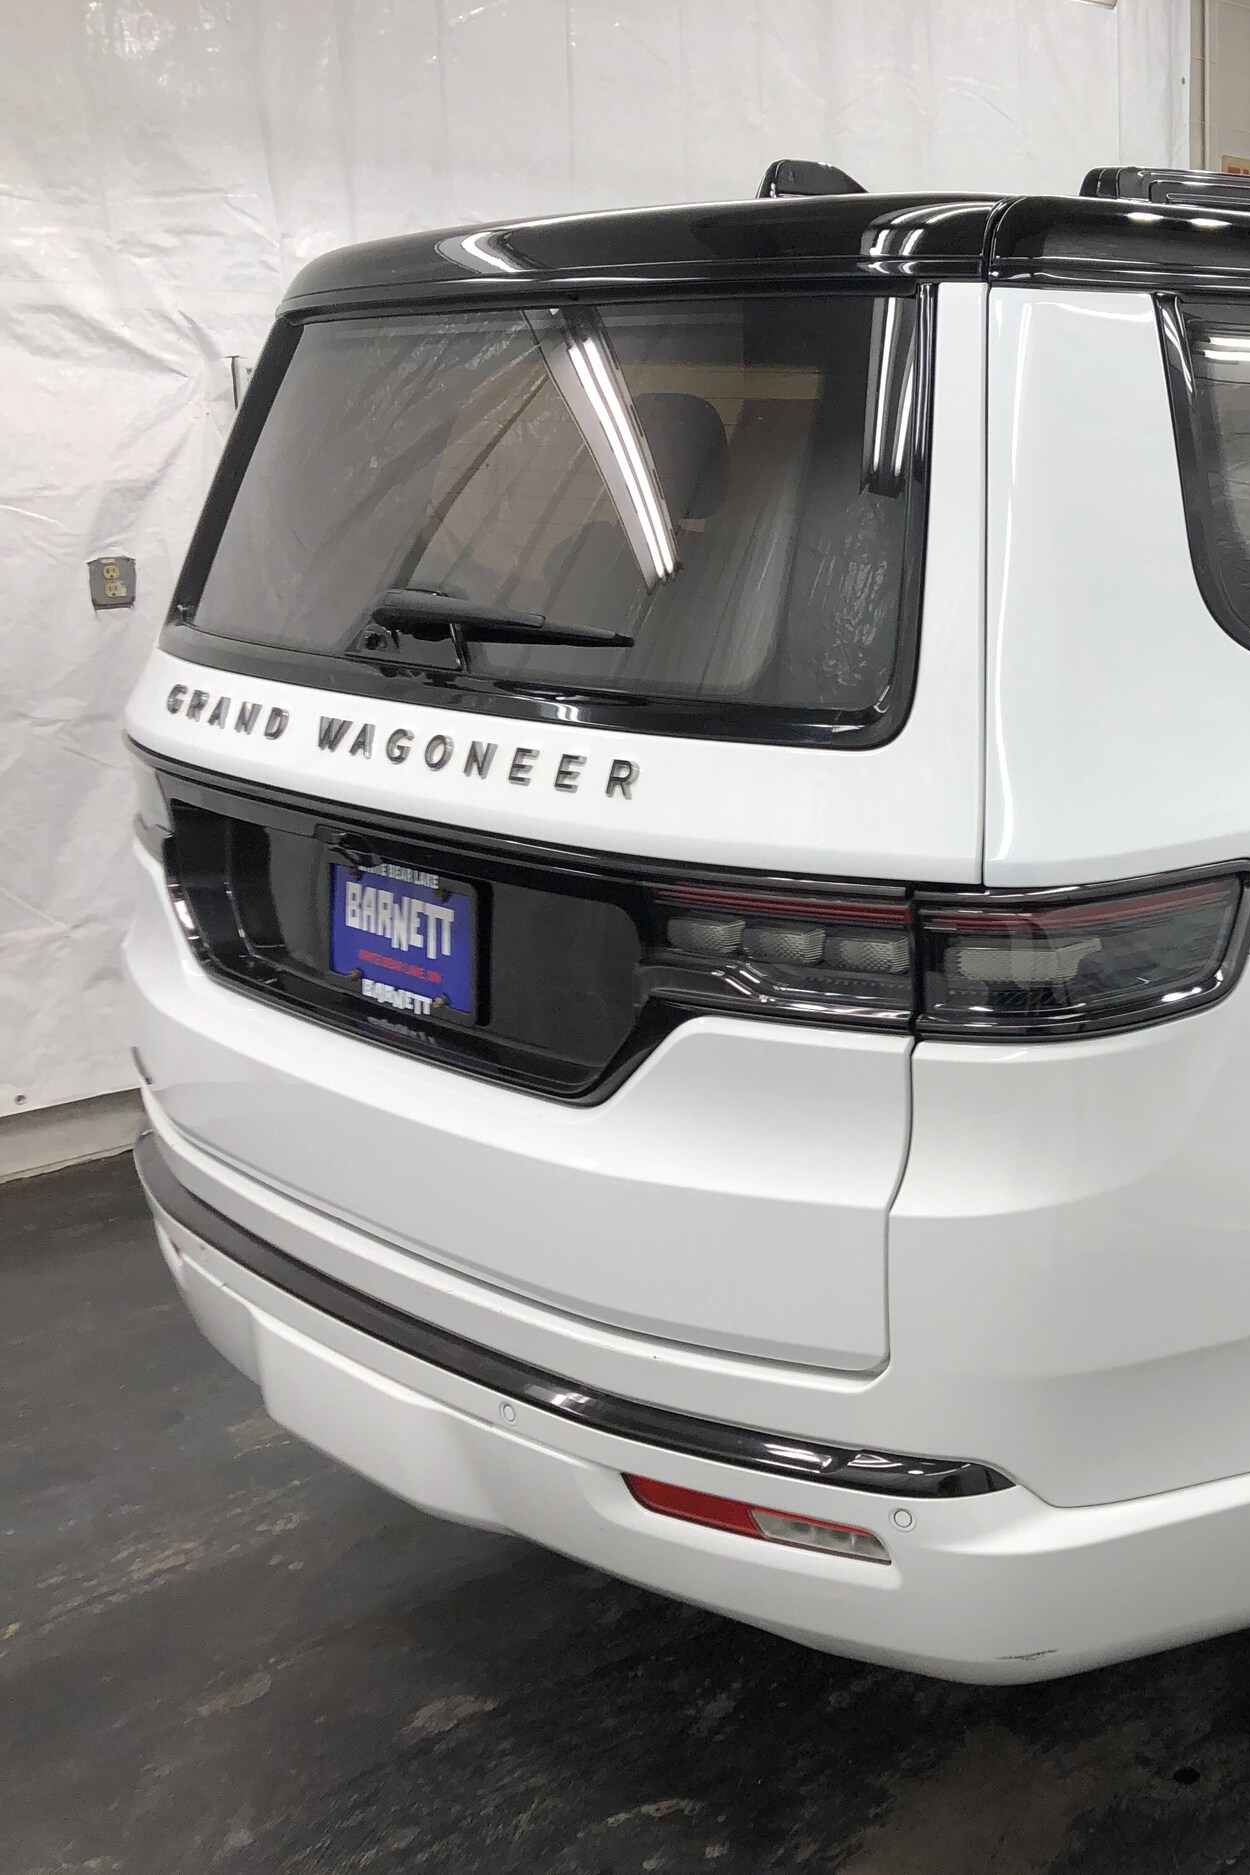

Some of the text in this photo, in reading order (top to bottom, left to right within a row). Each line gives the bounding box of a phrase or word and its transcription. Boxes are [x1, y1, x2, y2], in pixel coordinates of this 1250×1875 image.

[166, 683, 640, 800] GRAND WAGONEER
[345, 881, 455, 960] BARNETT
[361, 978, 433, 1015] BARNETT
